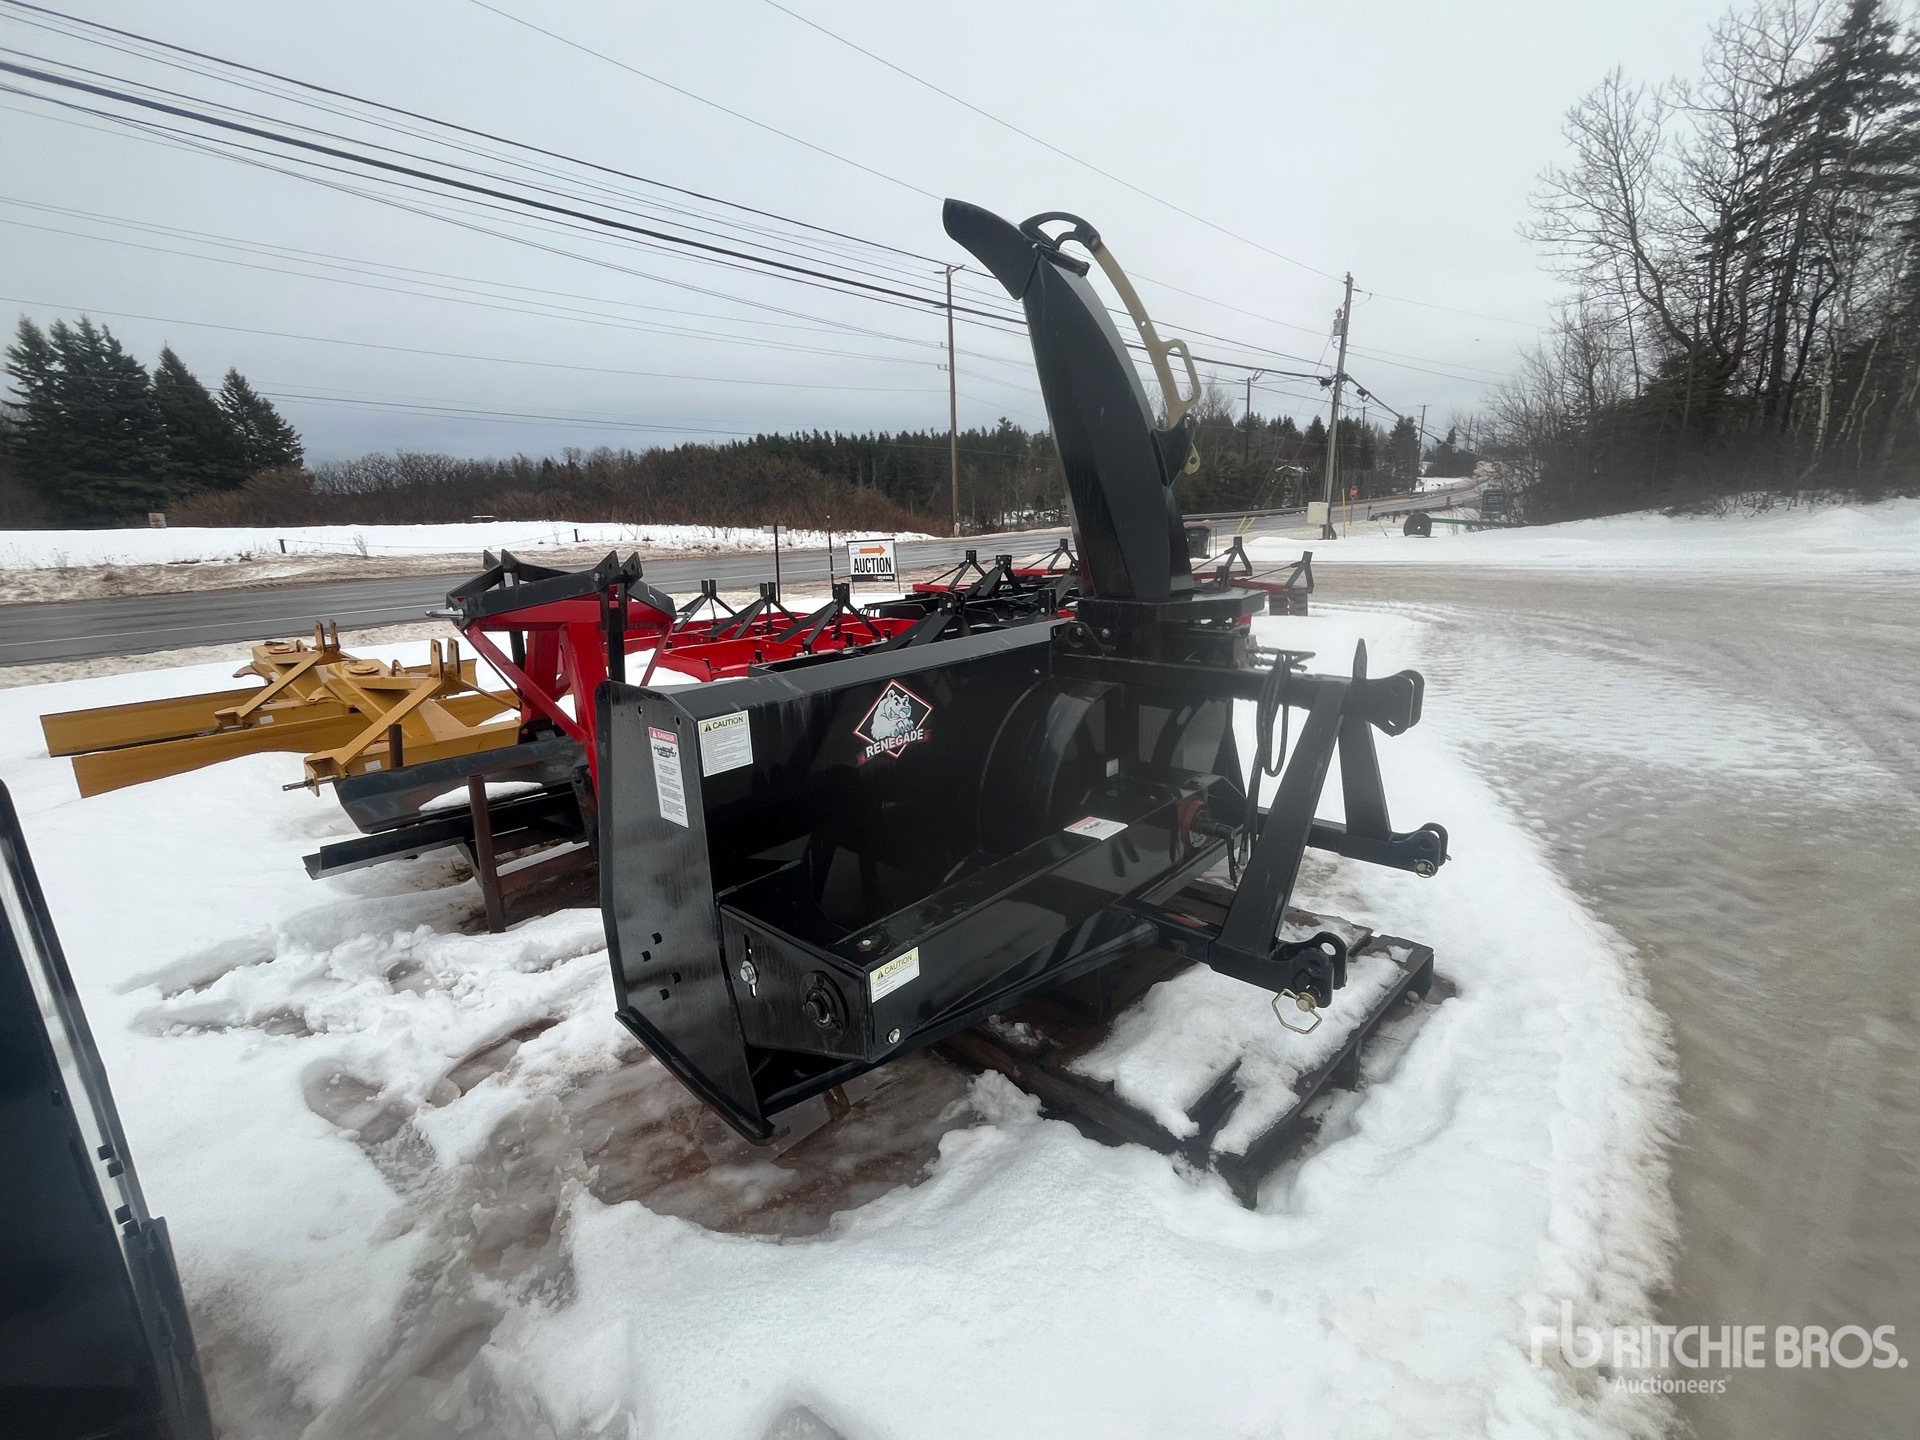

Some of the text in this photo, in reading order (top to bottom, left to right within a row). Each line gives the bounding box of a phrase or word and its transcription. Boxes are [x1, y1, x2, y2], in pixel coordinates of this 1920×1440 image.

[853, 557, 892, 573] AUCTION
[712, 716, 744, 730] CAUTION
[865, 729, 924, 758] RENEGADE
[884, 953, 913, 975] CAUTION
